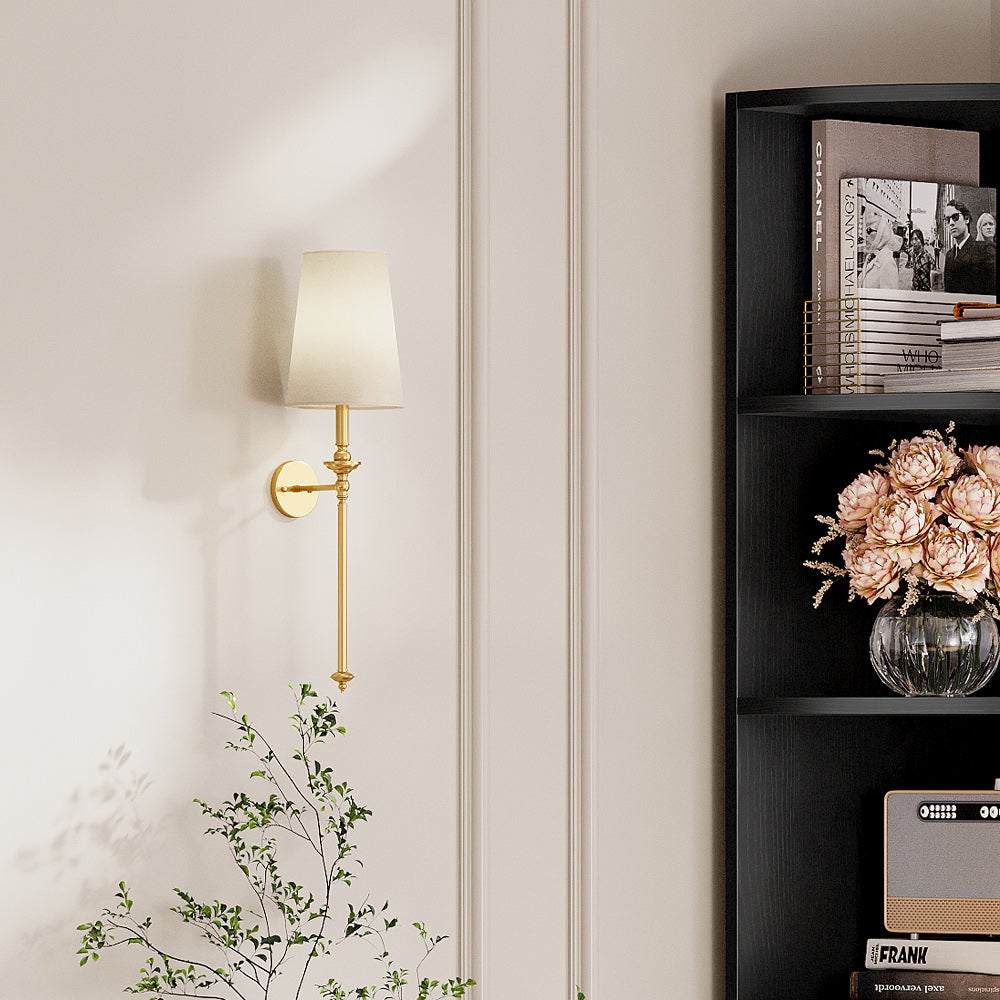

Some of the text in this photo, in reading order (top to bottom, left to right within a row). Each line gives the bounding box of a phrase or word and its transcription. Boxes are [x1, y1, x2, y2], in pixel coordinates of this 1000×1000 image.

[815, 140, 823, 252] CHANEL
[844, 194, 855, 394] WHO IS MICHAEL JANG?
[902, 349, 939, 363] WHO
[879, 945, 929, 964] FRANK
[875, 984, 945, 993] axel vervoordt
